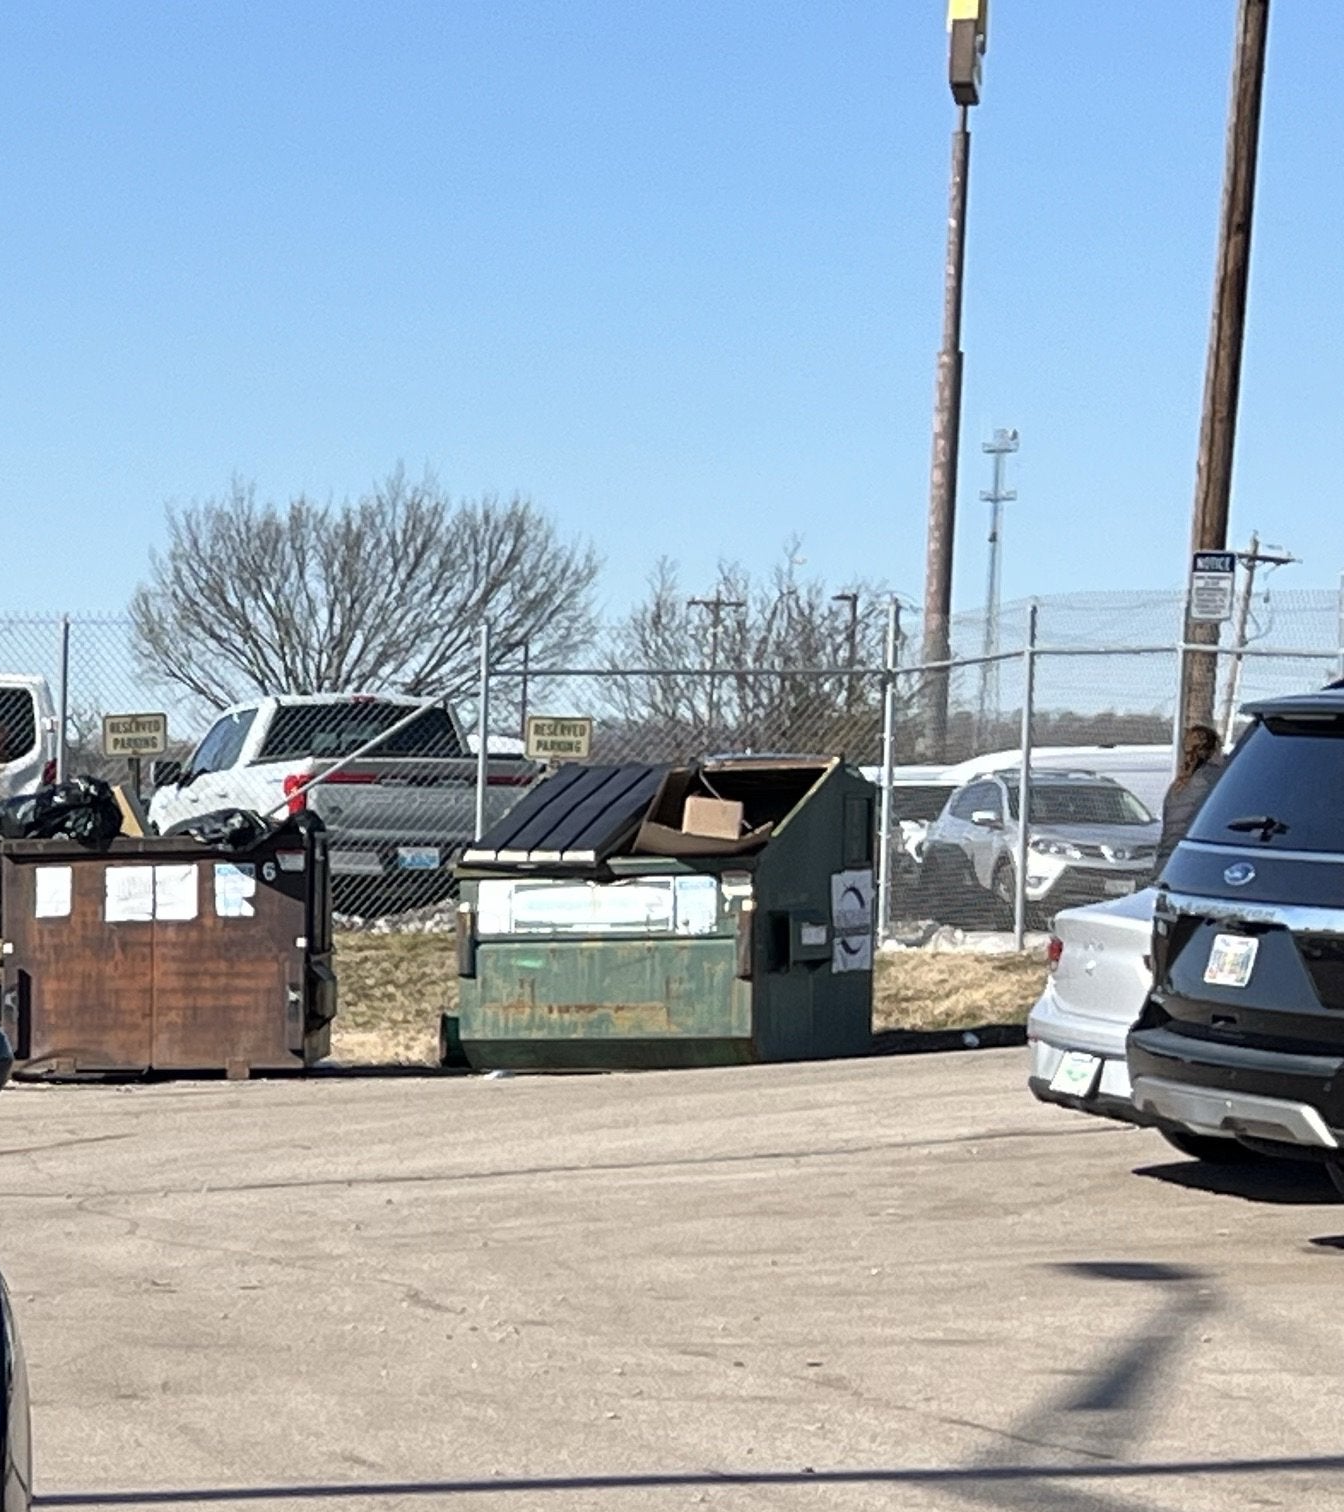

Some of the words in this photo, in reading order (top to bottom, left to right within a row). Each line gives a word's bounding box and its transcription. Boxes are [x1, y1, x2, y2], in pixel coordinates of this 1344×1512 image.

[109, 720, 161, 734] RESERVED
[533, 723, 588, 738] RESERVED
[112, 735, 158, 750] PARKING
[536, 739, 582, 753] PARKING
[262, 861, 277, 882] 6
